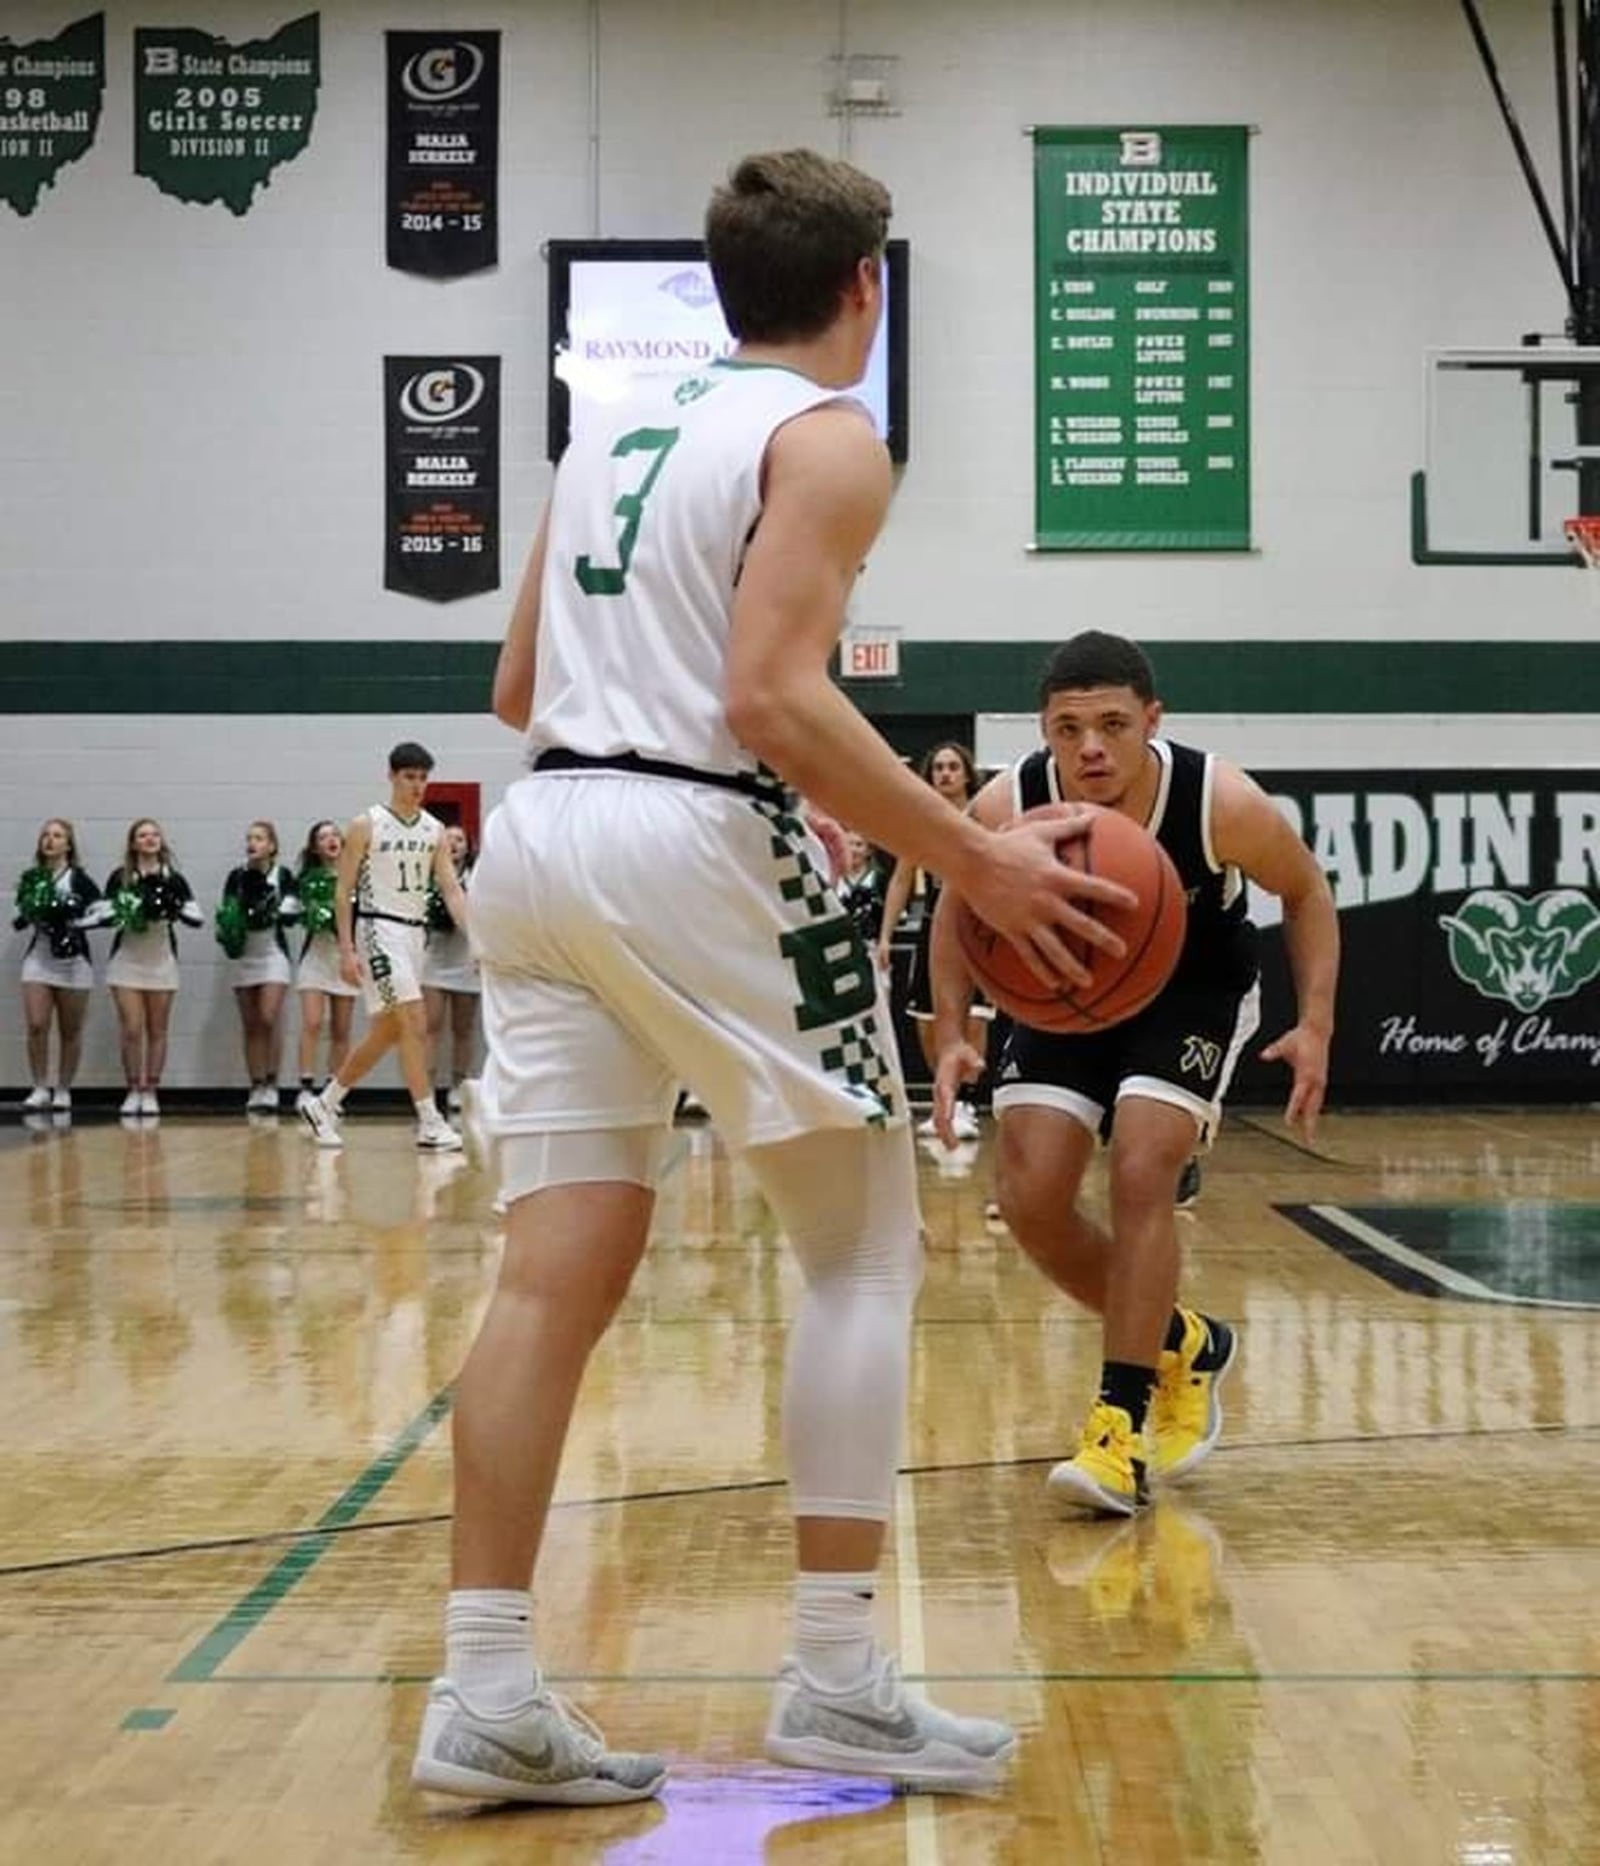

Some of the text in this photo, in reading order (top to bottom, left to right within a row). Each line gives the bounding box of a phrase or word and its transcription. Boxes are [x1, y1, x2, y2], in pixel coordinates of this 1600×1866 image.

[13, 55, 95, 80] Champions
[183, 55, 223, 75] State
[228, 54, 312, 80] Champions
[174, 87, 262, 108] 2005
[149, 110, 303, 131] Girls Soccer
[170, 138, 246, 156] DIVISION
[415, 133, 470, 149] MALIA
[1065, 171, 1218, 196] INDIVIDUAL
[401, 213, 443, 231] 2014
[463, 213, 482, 231] 15
[1101, 200, 1182, 225] STATE
[1066, 228, 1217, 253] CHAMPIONS
[585, 340, 710, 360] RAYMOND
[415, 456, 470, 470] MALIA
[574, 426, 680, 595] 3
[401, 536, 443, 552] 2015
[463, 536, 482, 552] 16
[853, 643, 889, 671] EXIT
[779, 913, 878, 1031] B
[1380, 1015, 1469, 1054] Home
[1475, 1017, 1506, 1067] of
